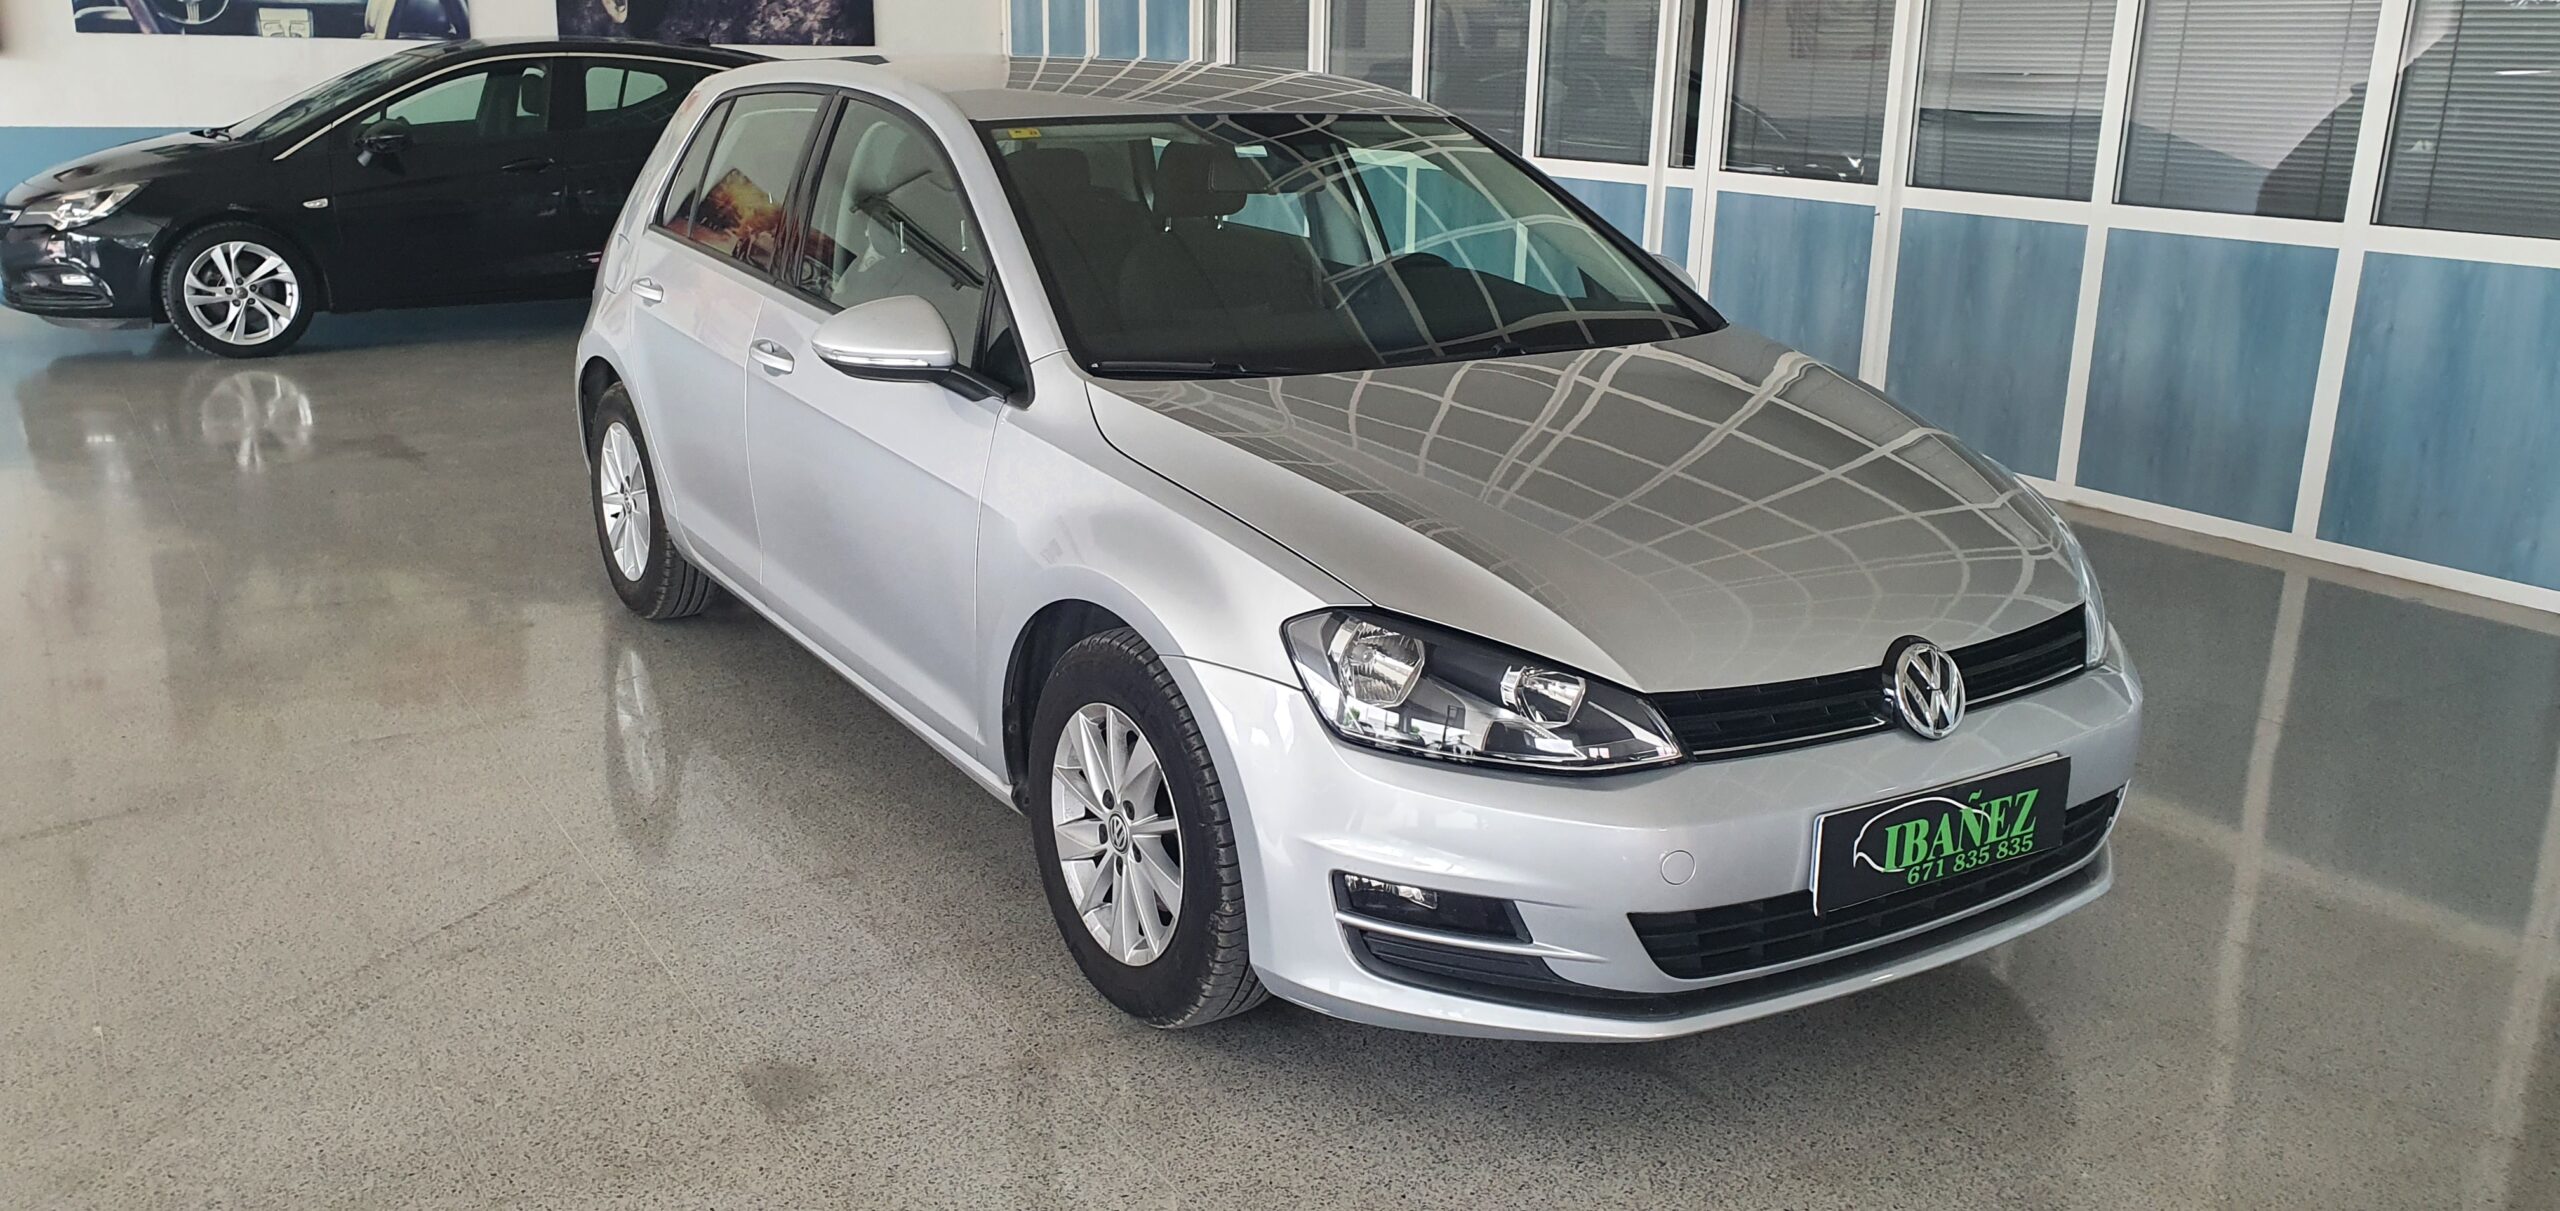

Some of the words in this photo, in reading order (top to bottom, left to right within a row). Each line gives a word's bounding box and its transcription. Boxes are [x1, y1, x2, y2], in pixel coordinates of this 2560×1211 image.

[1883, 789, 2039, 871] IBAÑEZ
[1907, 860, 1945, 885] 671
[1953, 845, 1990, 872] 835
[1996, 834, 2034, 859] 835
